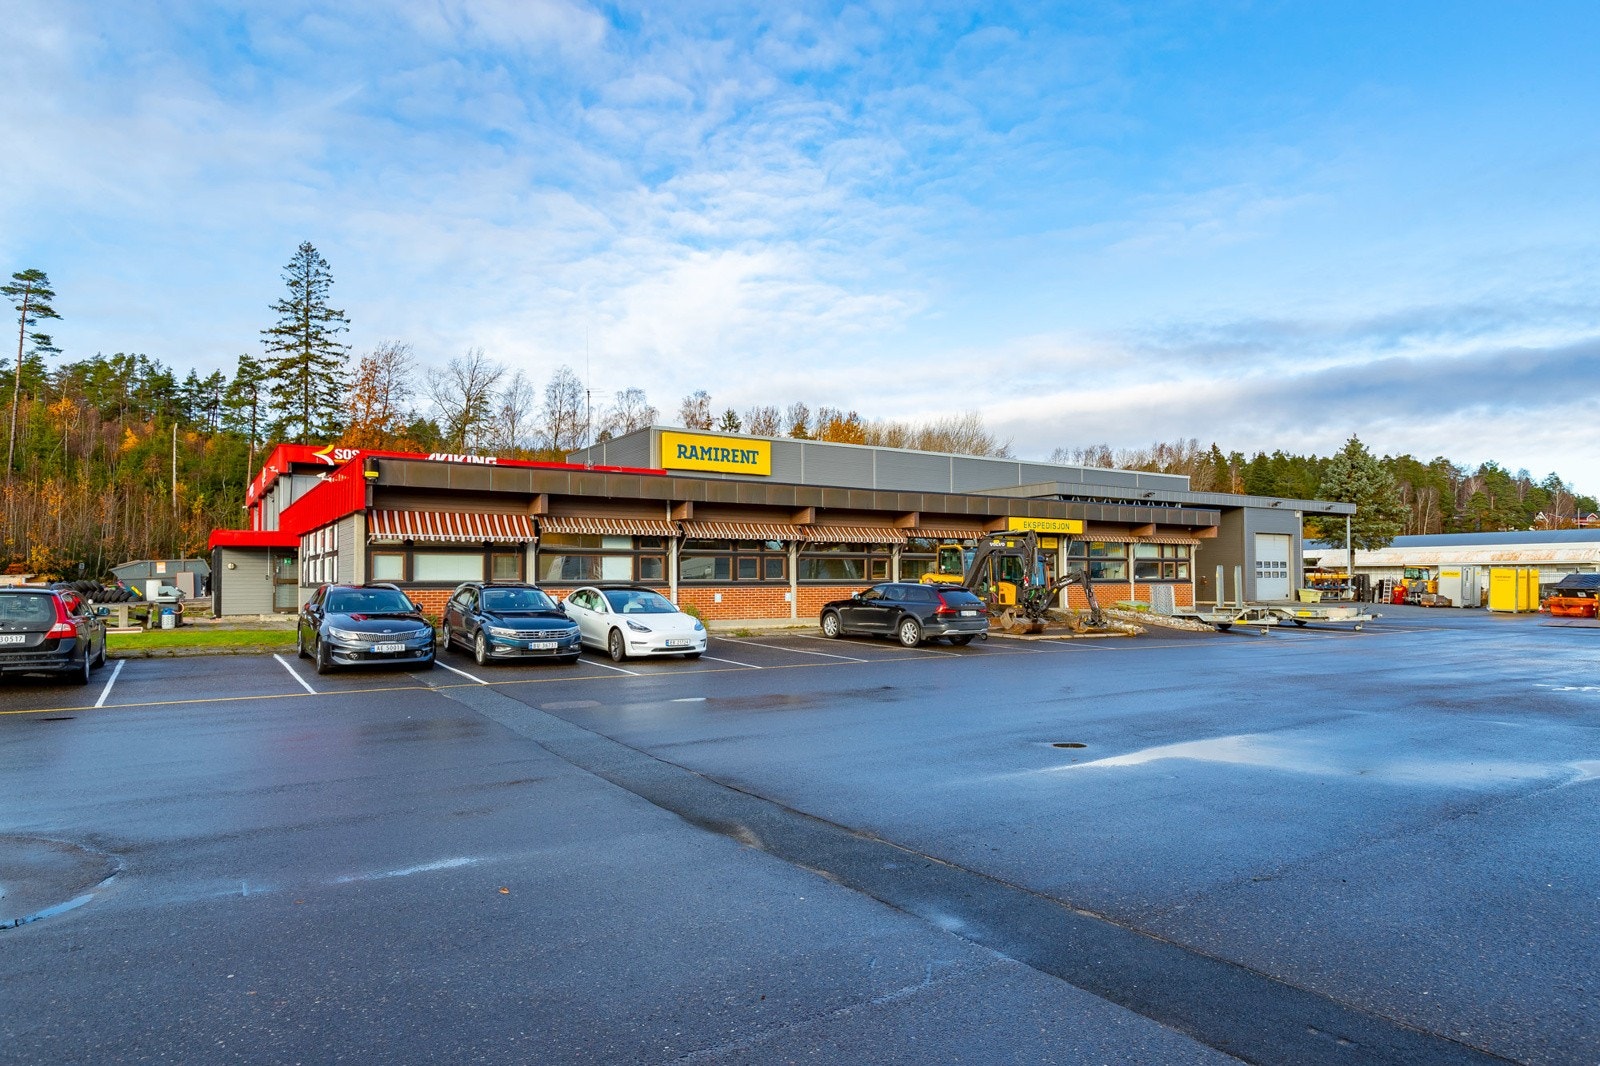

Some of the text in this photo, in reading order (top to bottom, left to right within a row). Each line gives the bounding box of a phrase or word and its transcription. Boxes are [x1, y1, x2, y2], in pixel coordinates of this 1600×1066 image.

[335, 449, 360, 460] SOS
[677, 444, 759, 465] RAMIRENT
[1024, 521, 1070, 530] EKSPEDISJON
